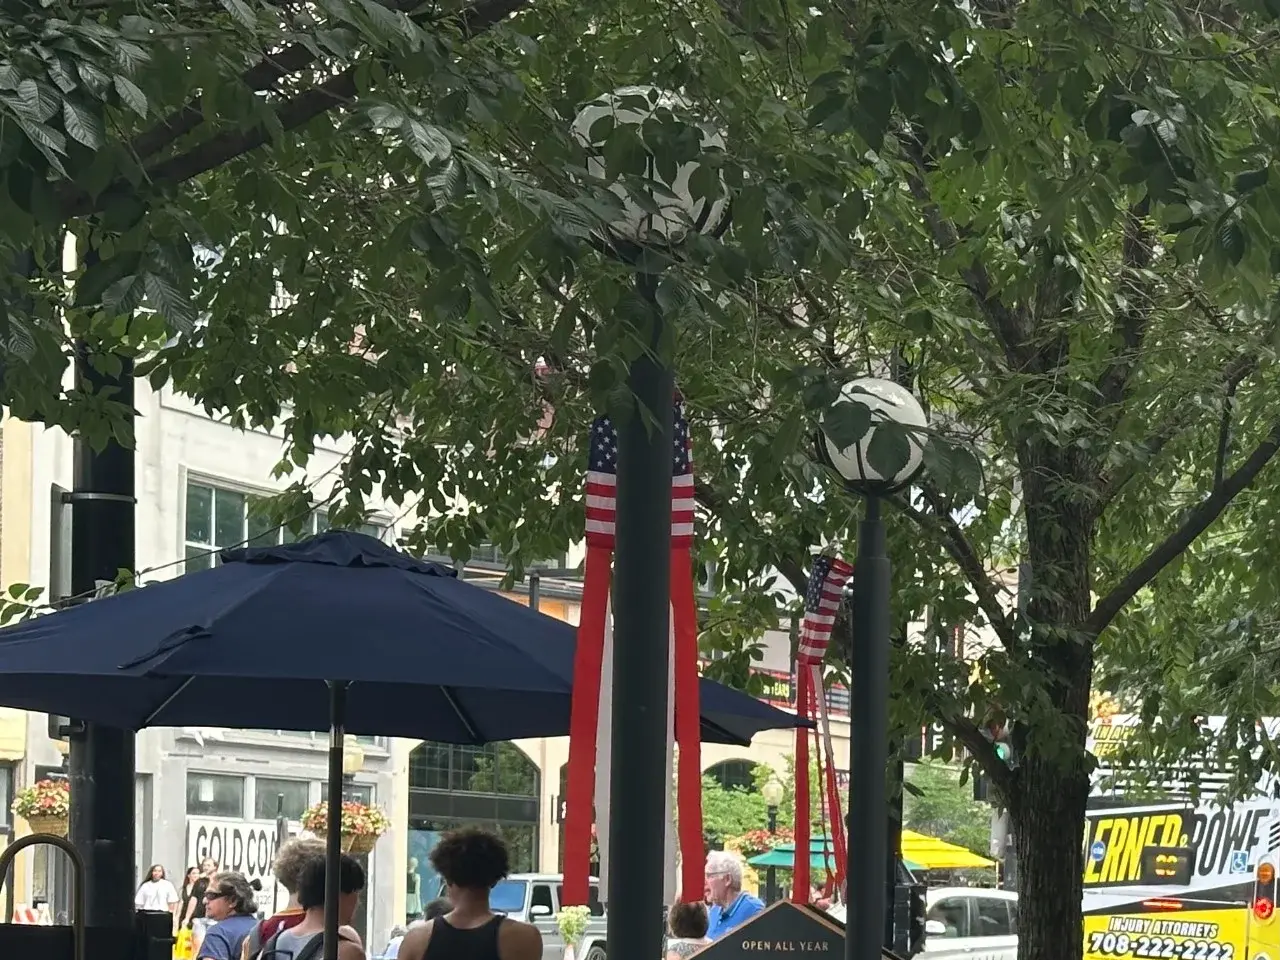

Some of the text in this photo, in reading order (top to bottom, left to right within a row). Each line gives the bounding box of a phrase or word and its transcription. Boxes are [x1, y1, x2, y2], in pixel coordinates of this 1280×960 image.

[196, 825, 278, 876] GOLD COA
[1083, 813, 1183, 883] ERNER
[742, 940, 829, 951] OPEN ALL YEAR
[1108, 917, 1218, 939] INJURY ATTORNEYS
